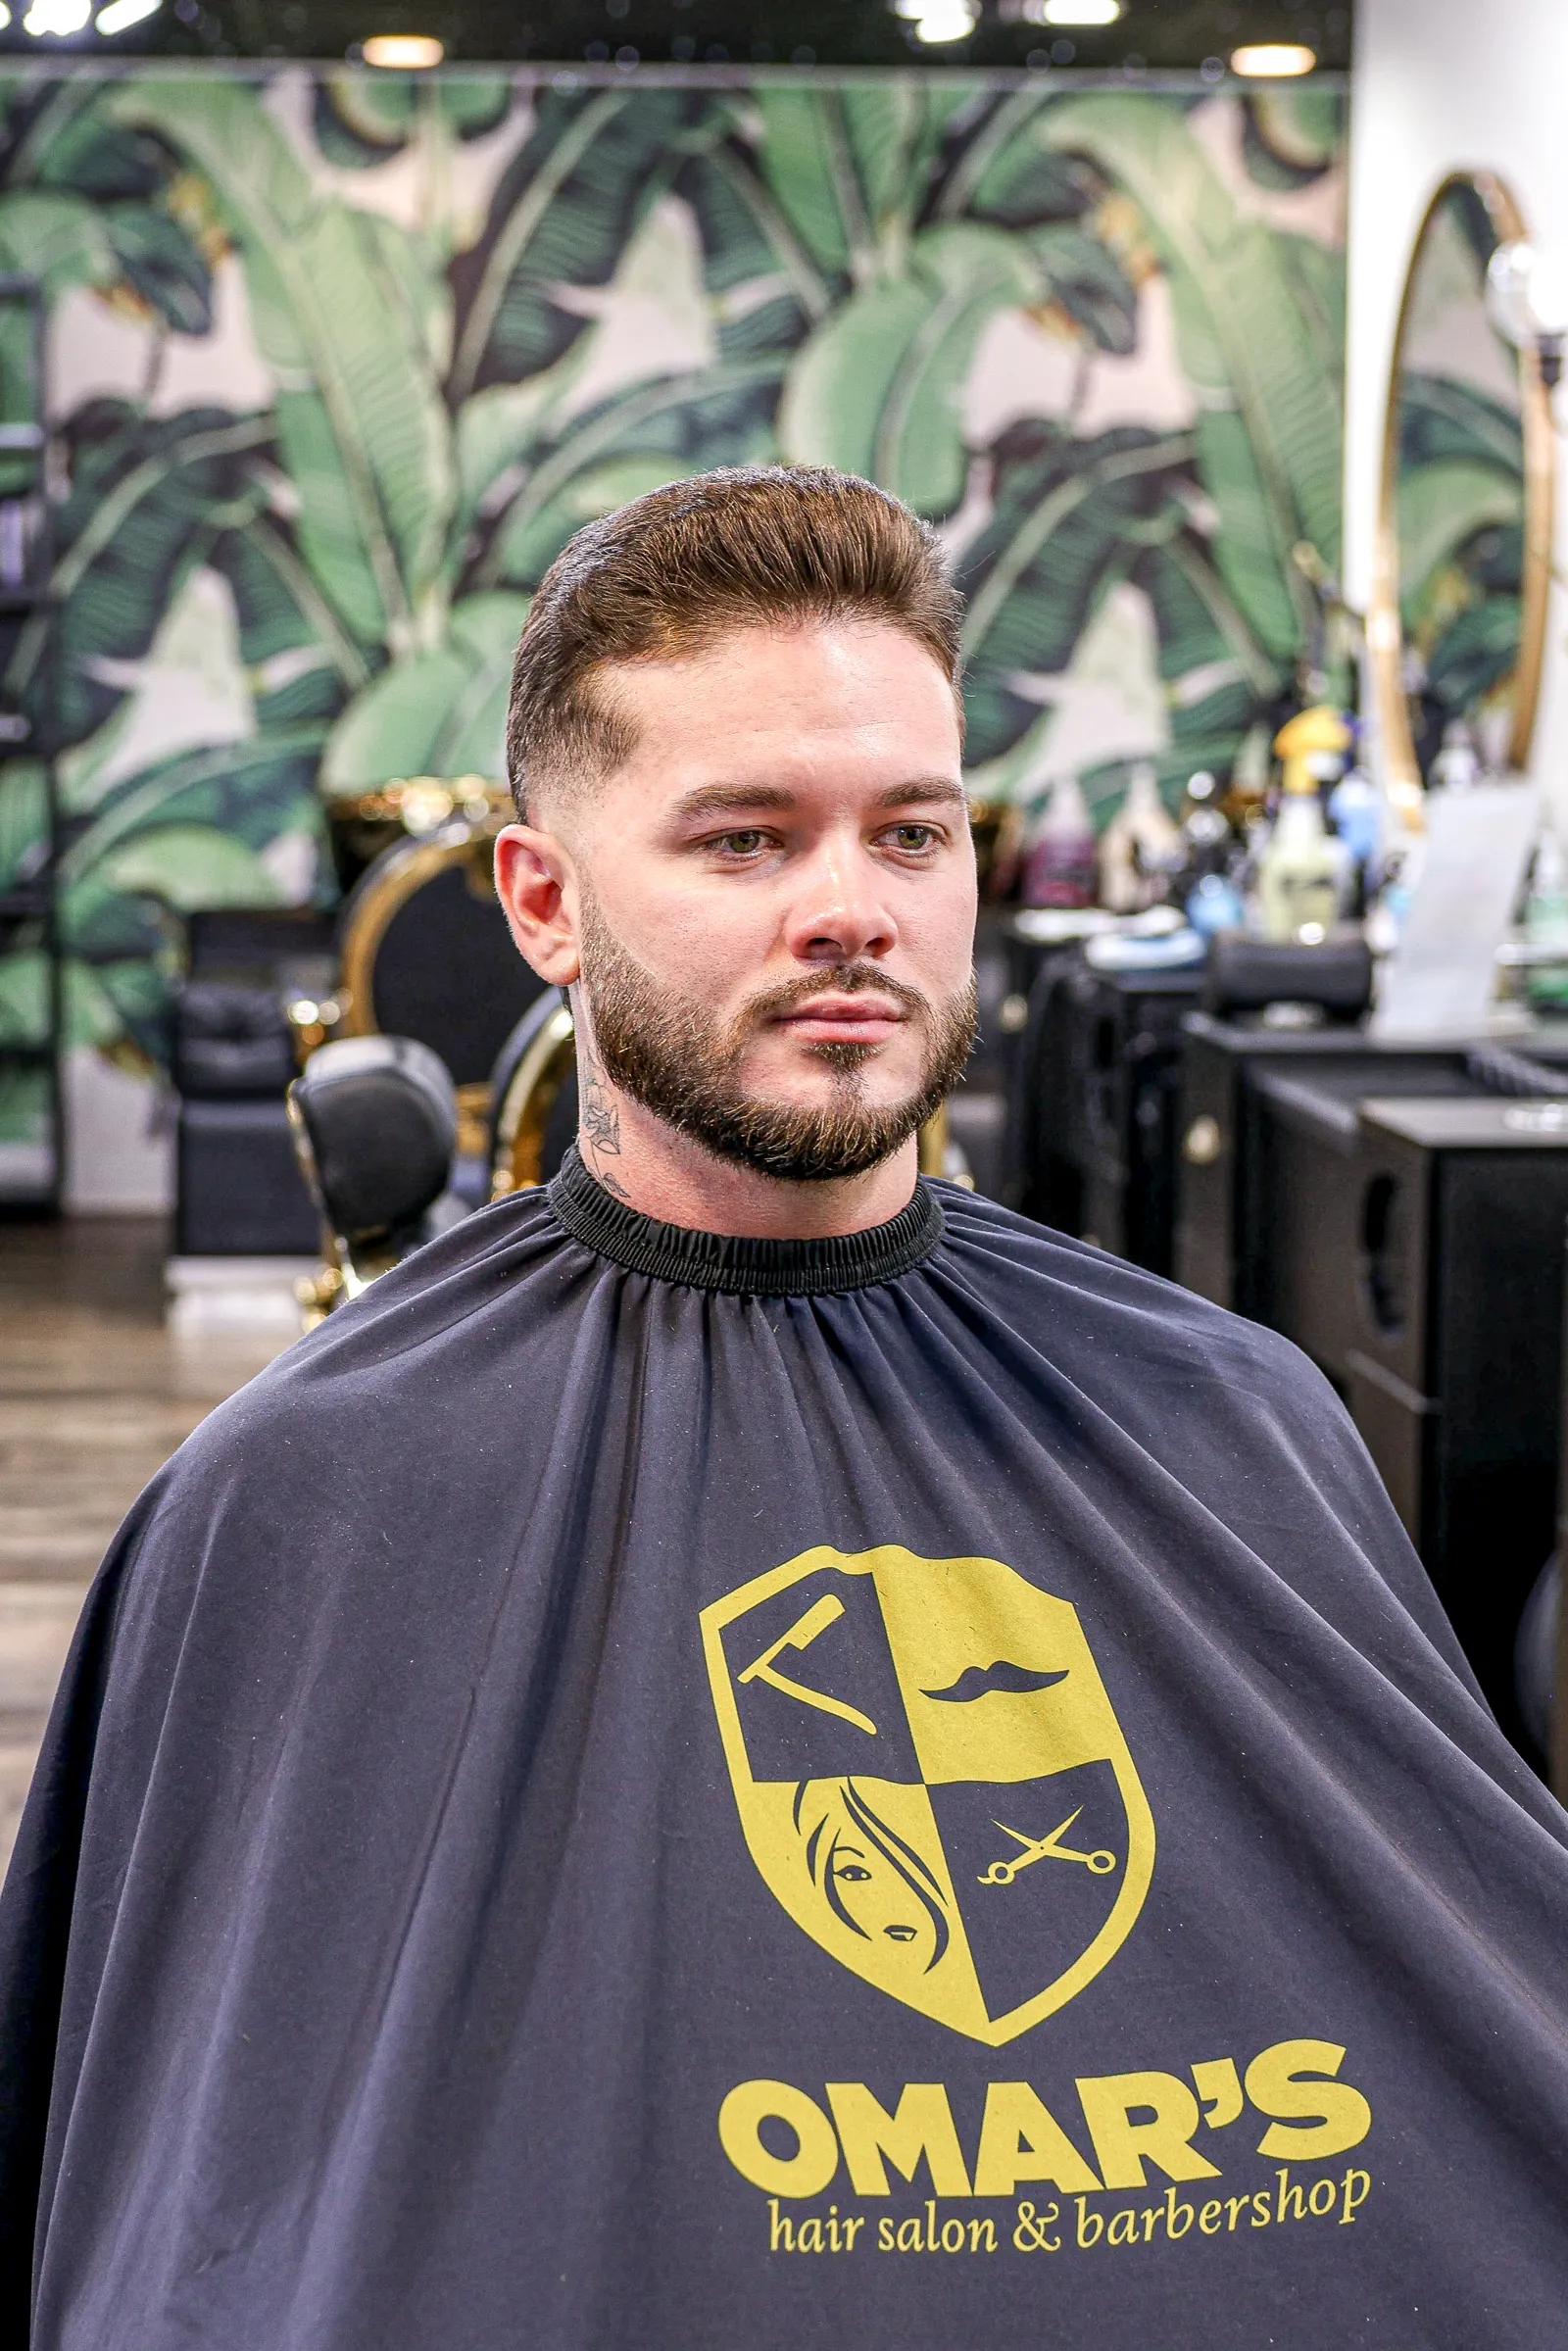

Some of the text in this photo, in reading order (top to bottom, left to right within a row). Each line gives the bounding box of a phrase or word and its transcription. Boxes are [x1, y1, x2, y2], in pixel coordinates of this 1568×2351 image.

[718, 2038, 1373, 2200] OMAR’S
[767, 2167, 1372, 2254] hair salon & barbershop
